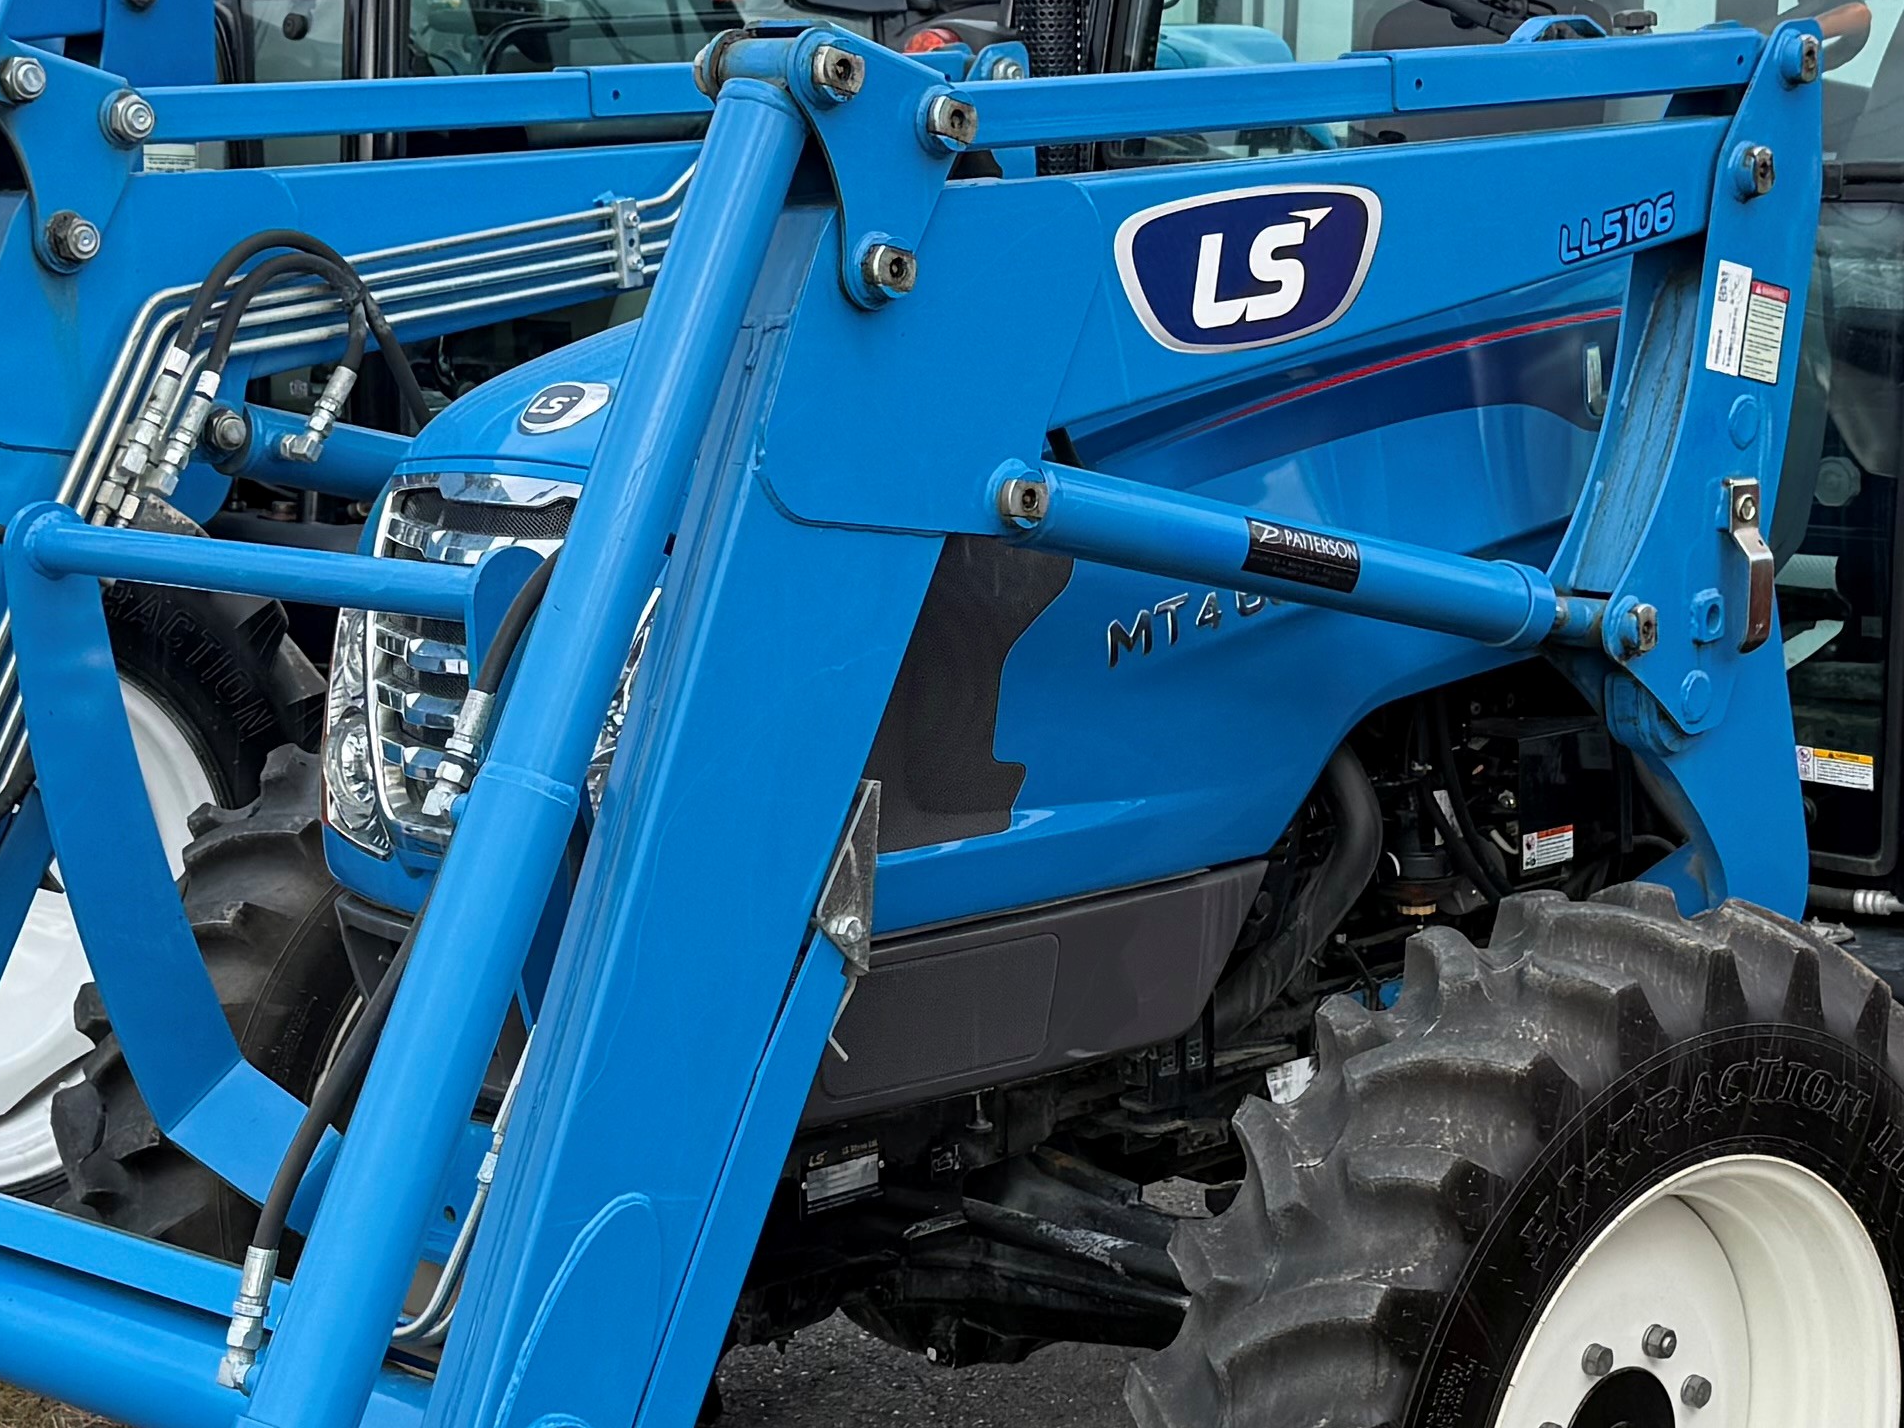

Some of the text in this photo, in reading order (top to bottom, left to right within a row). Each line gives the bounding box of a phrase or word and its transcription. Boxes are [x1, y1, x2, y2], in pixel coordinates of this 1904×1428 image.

[1559, 190, 1675, 265] LL5106
[1192, 220, 1306, 329] LS
[528, 396, 571, 415] LS
[1283, 529, 1358, 561] PATTERSON
[103, 583, 275, 743] RACTION
